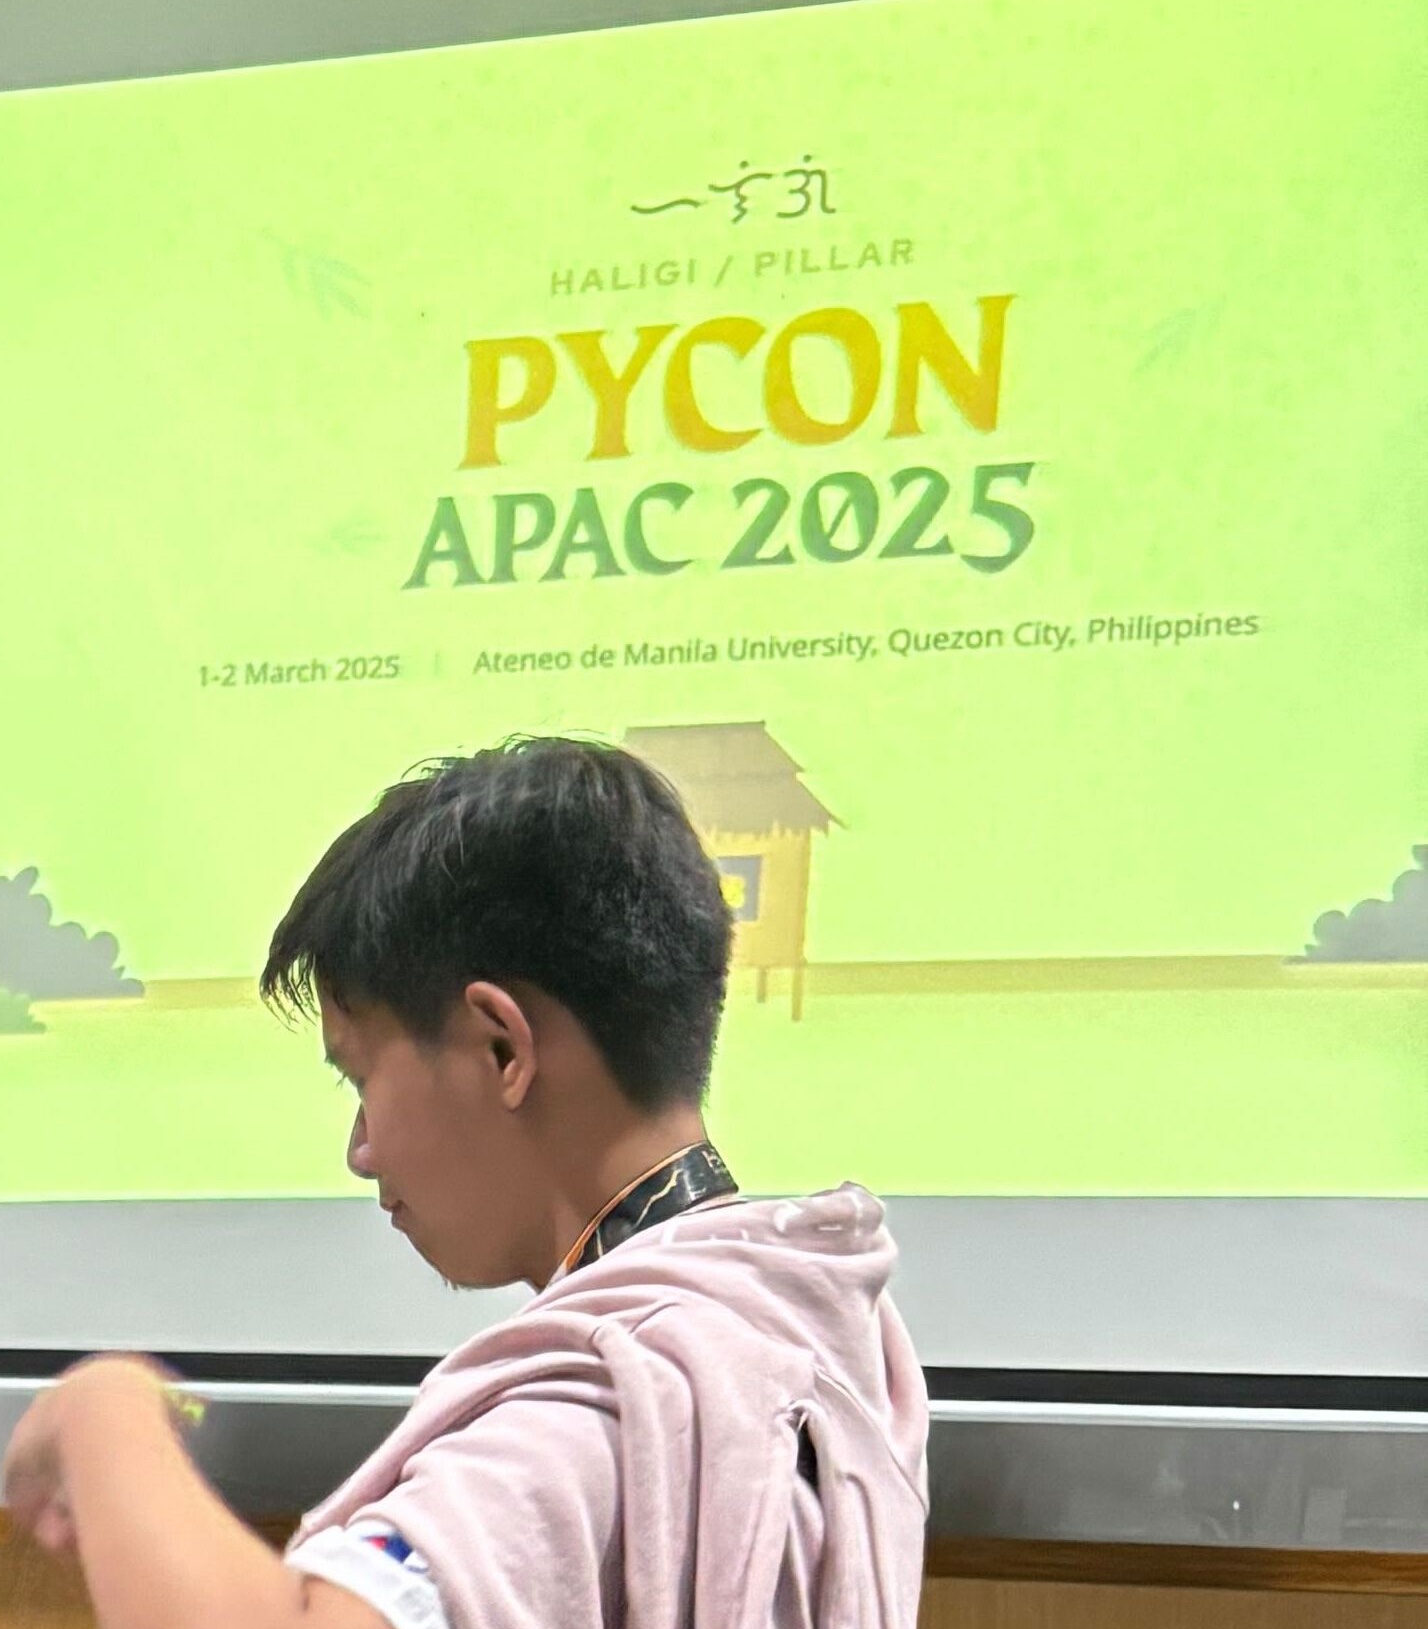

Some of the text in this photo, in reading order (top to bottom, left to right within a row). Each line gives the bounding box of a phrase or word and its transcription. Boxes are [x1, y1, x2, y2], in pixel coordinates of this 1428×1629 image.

[550, 259, 697, 298] HALIGI
[753, 238, 916, 278] PILLAR
[457, 294, 1017, 470] PYCON
[400, 460, 1037, 590] APAC 2025
[197, 654, 401, 688] 1-2 March 2025
[472, 612, 1260, 675] Ateneo de Manila University, Quezon City, Philippines
